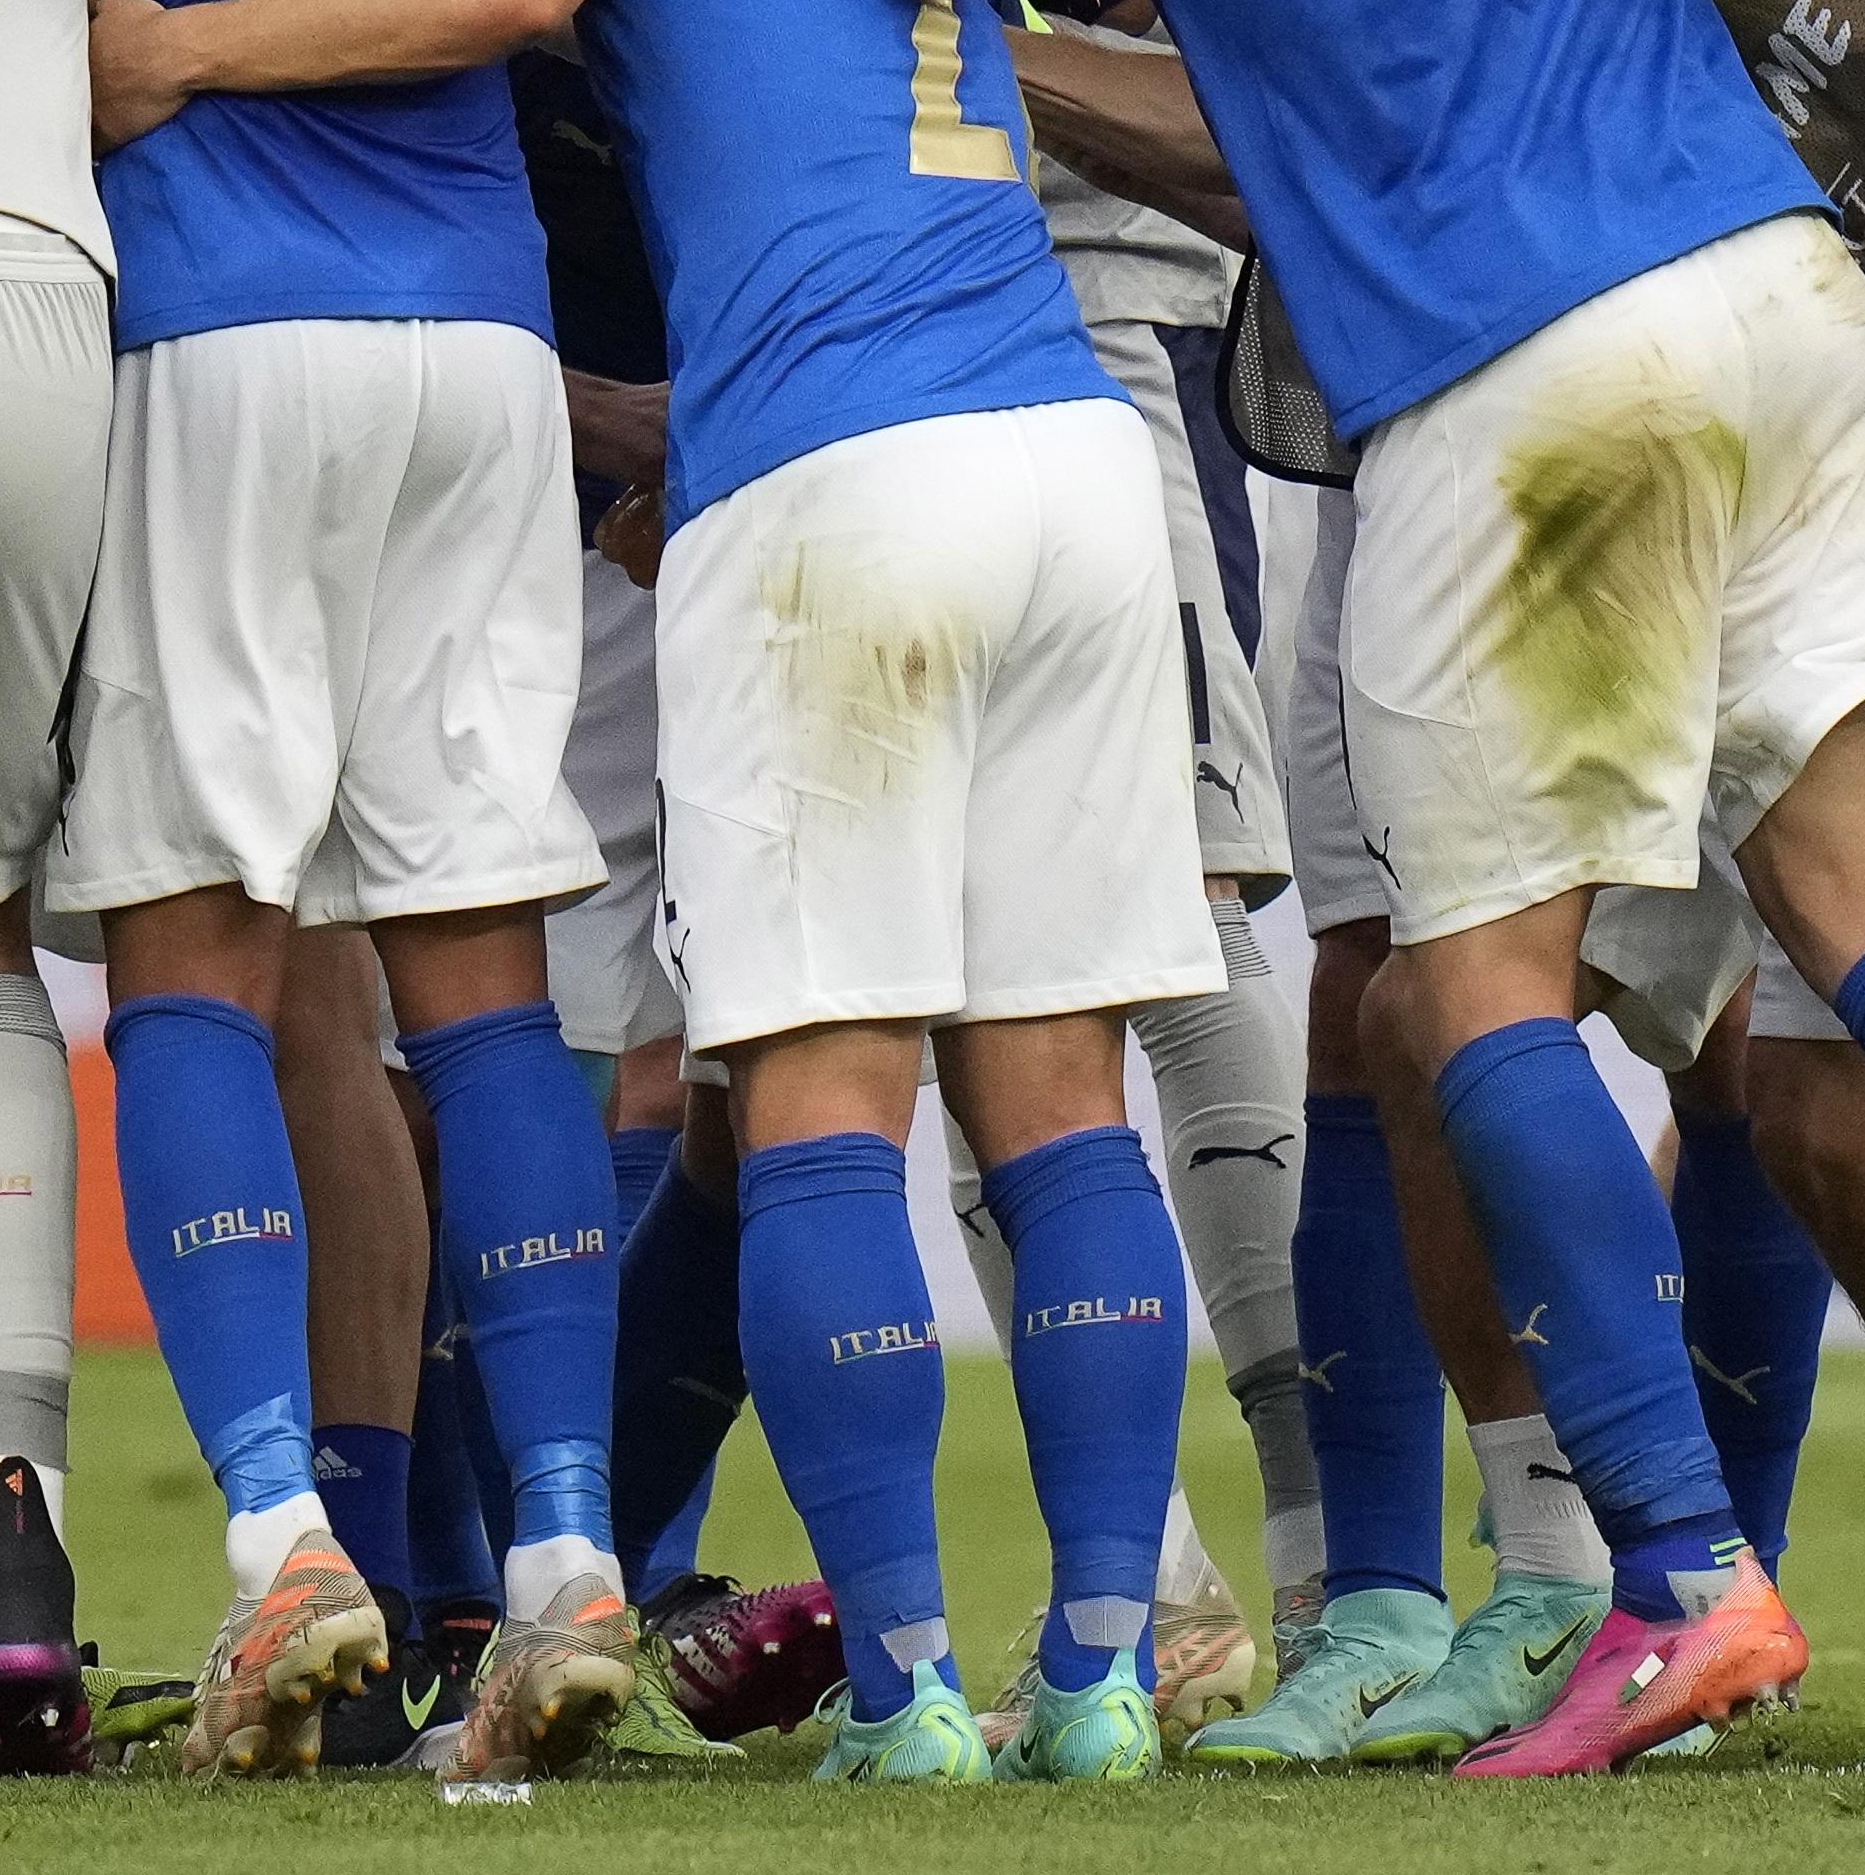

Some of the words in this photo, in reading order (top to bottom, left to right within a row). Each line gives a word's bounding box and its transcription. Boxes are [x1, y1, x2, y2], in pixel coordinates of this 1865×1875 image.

[173, 1207, 293, 1256] ITALIA
[480, 1227, 605, 1277] ITALIA
[1026, 1296, 1162, 1334] ITALIA
